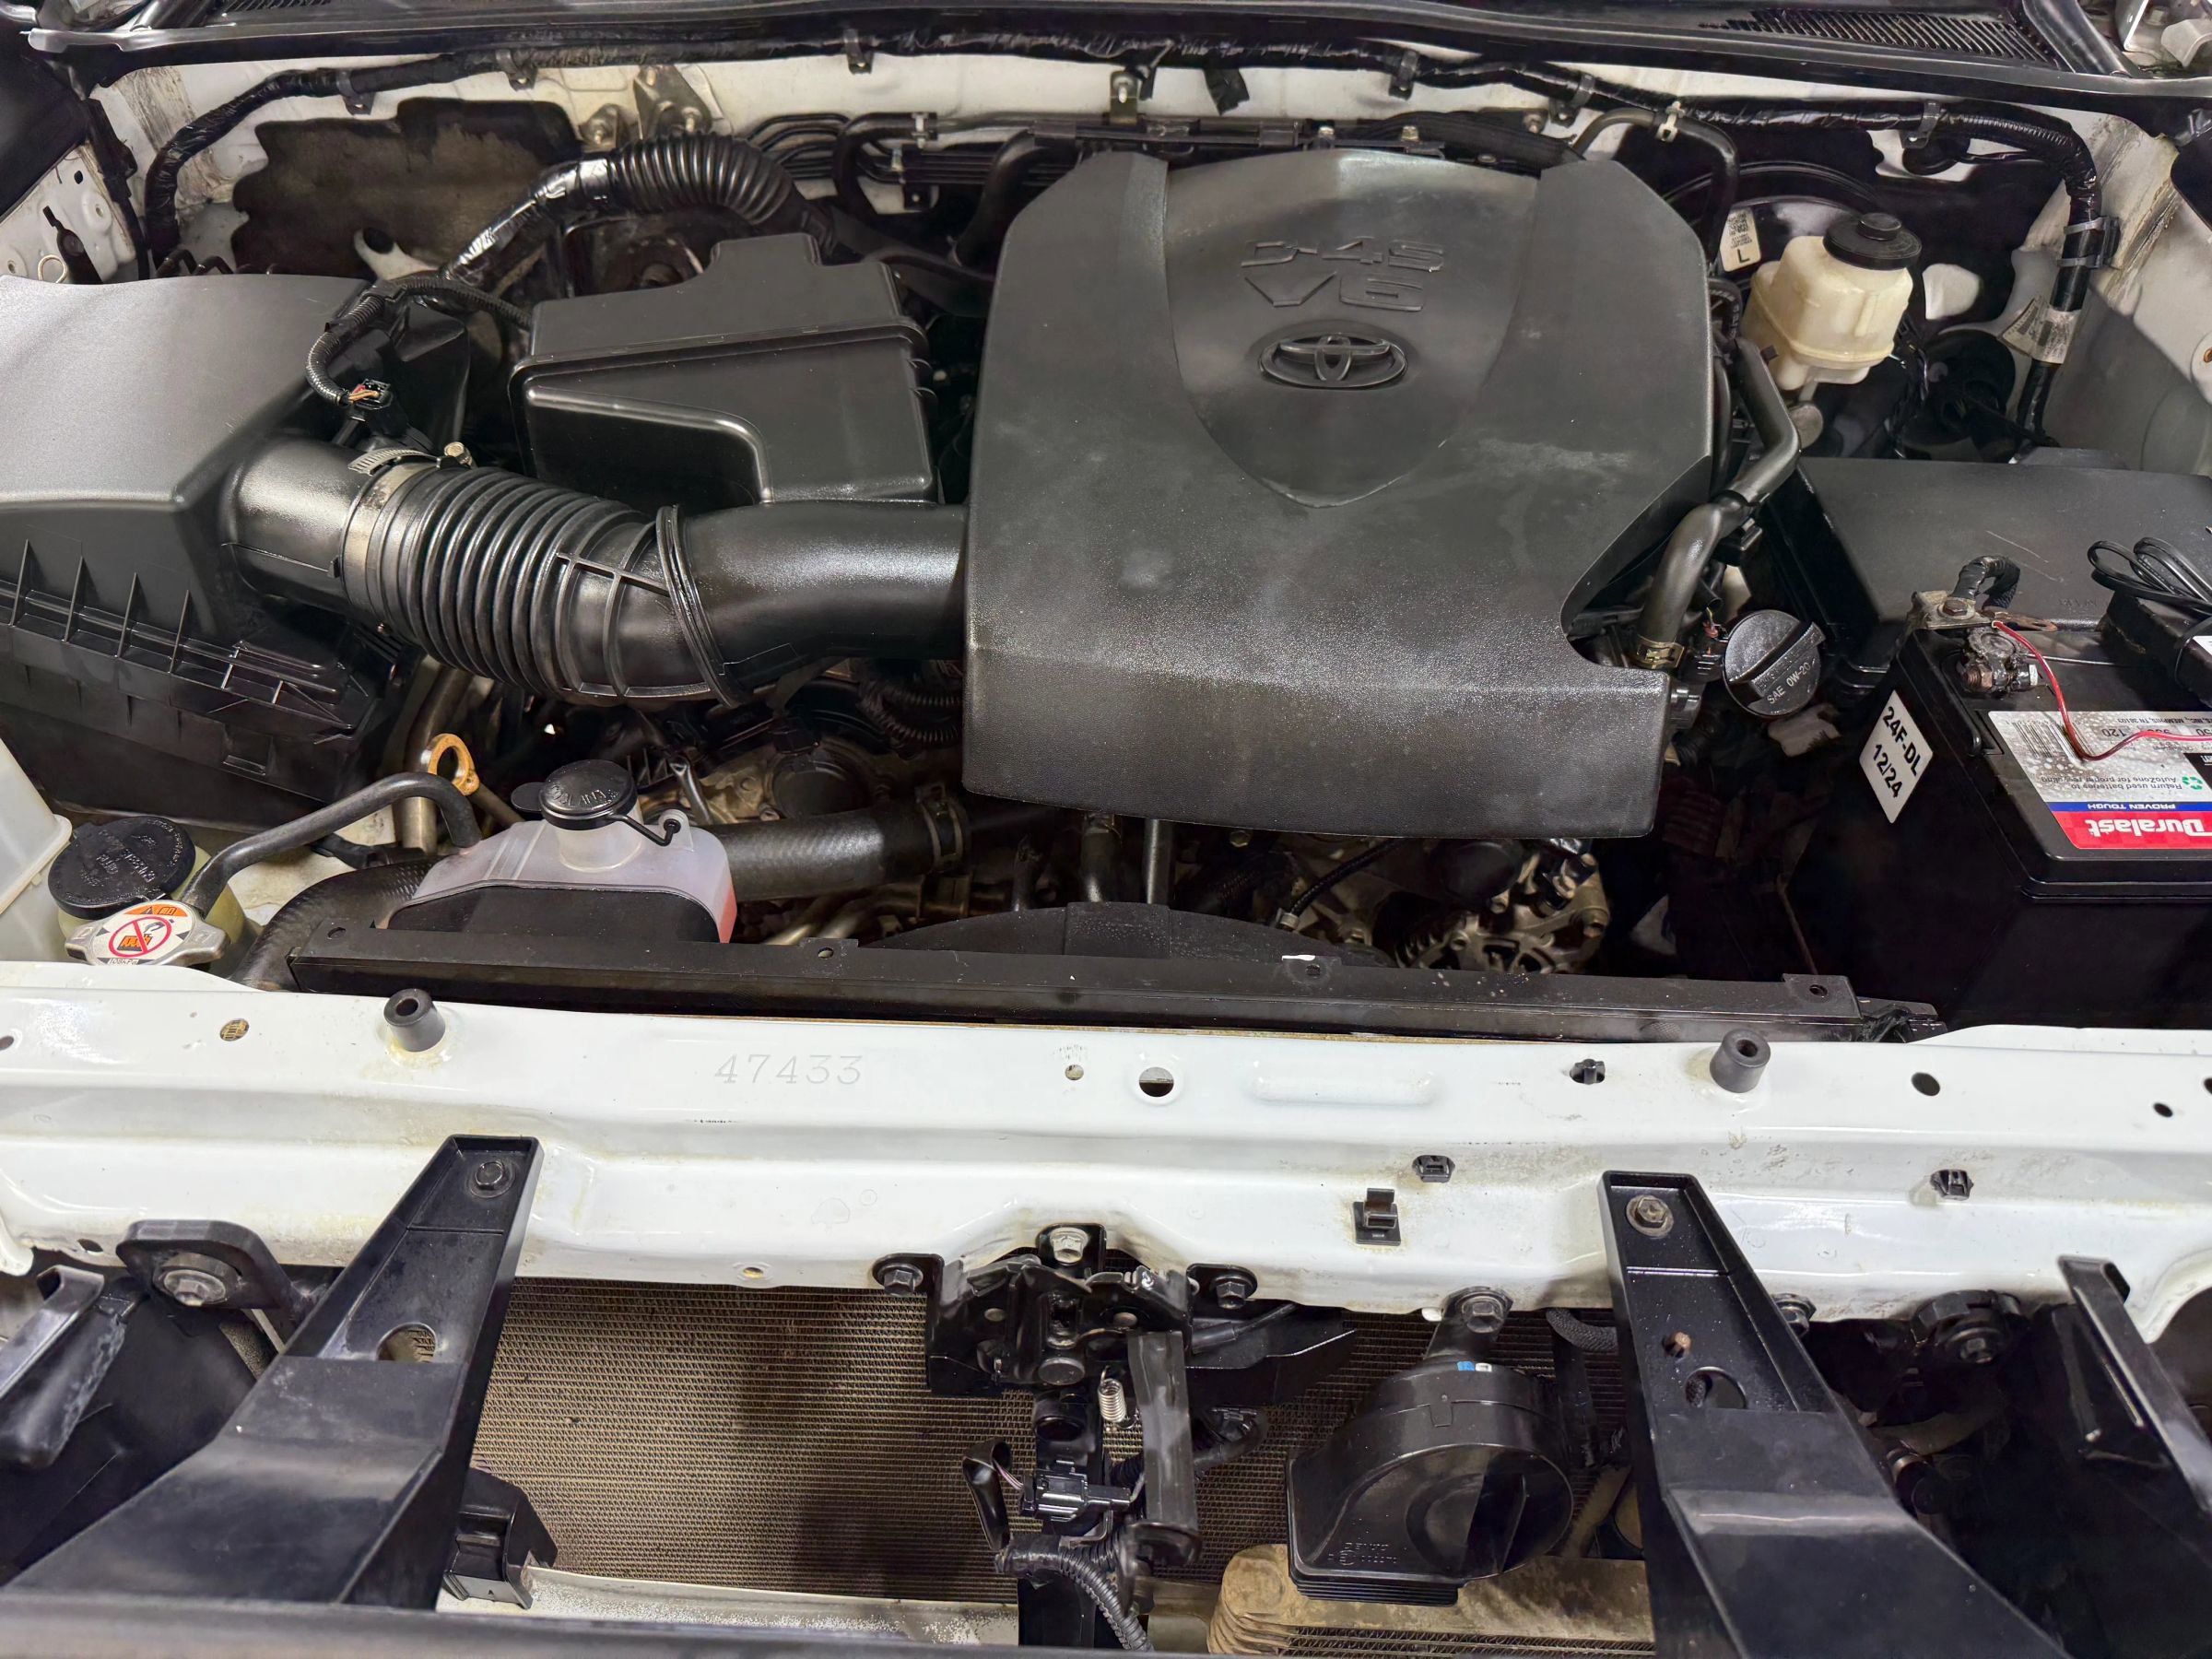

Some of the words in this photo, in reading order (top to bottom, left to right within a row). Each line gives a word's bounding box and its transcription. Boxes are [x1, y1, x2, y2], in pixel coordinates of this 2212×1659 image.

[1737, 249, 1750, 263] L
[1244, 270, 1425, 312] V6
[1767, 686, 1785, 704] SAE
[1786, 662, 1811, 688] 0W-20
[1883, 706, 1921, 776] 24F-DL
[2101, 728, 2126, 737] 120
[1874, 744, 1902, 798] 12/24
[2085, 818, 2212, 837] Duralast
[714, 1053, 863, 1085] 47433
